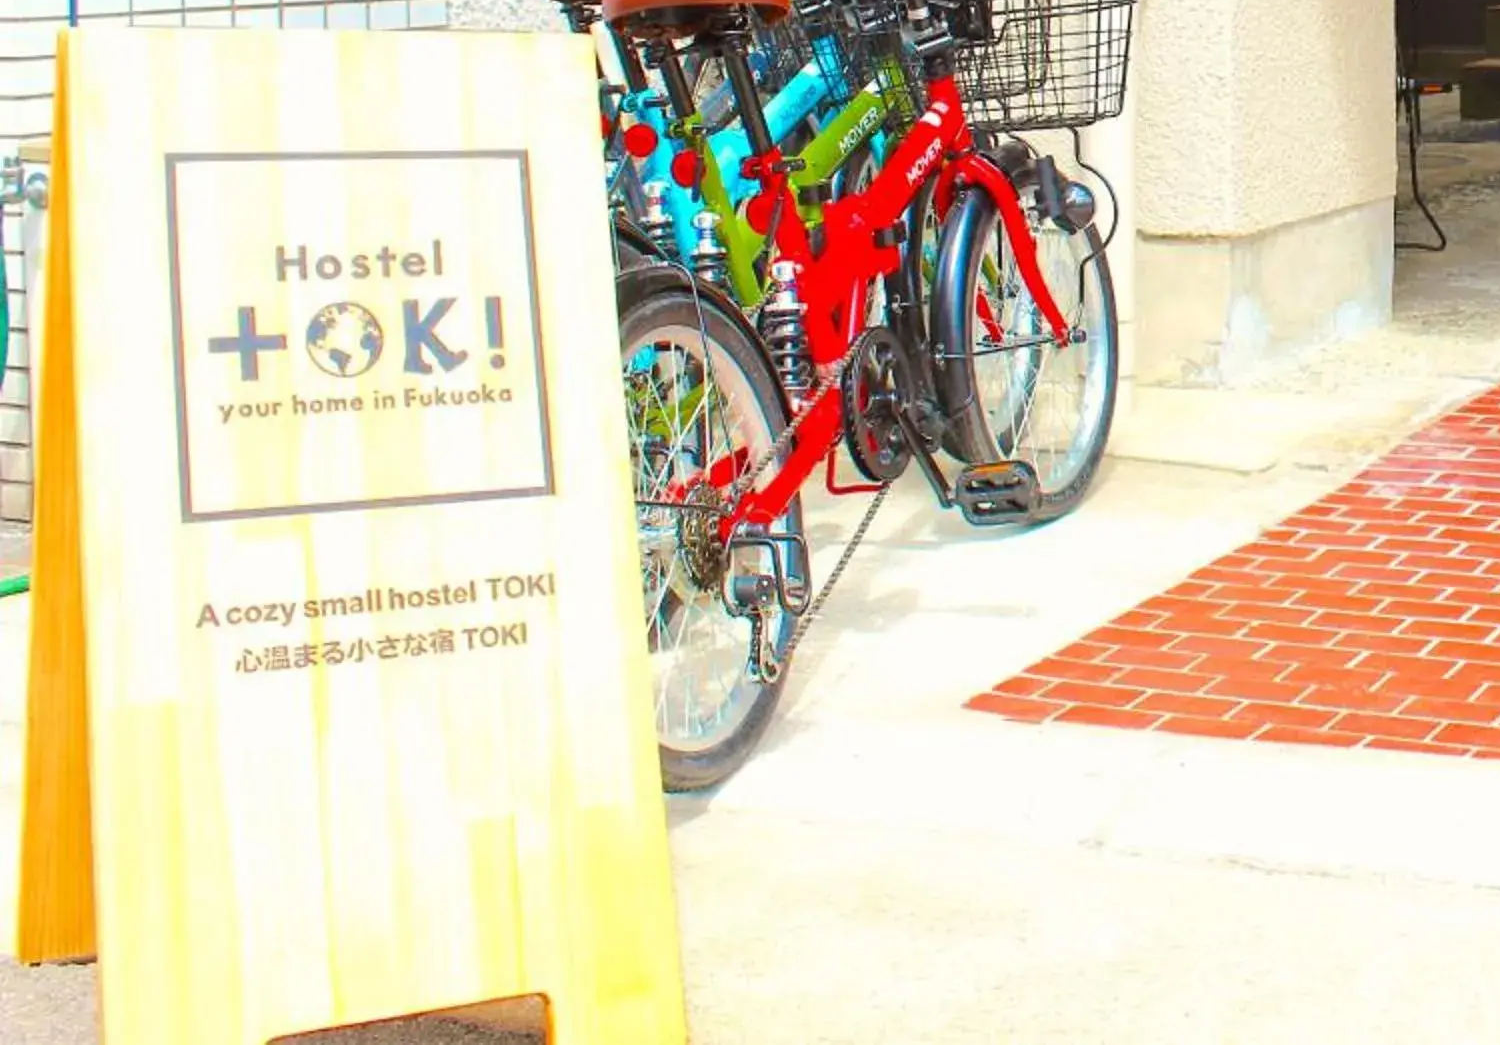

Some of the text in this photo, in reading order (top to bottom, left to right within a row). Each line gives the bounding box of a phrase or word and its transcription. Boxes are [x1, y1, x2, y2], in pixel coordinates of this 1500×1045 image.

[839, 106, 878, 154] MOVER
[905, 138, 942, 186] MOVER
[275, 238, 443, 282] Hostel
[219, 384, 513, 424] your home in Fukuoka
[196, 572, 556, 629] A cozy small hostel TOKI
[235, 622, 528, 674] 心温まる小さな宿 TOKI
